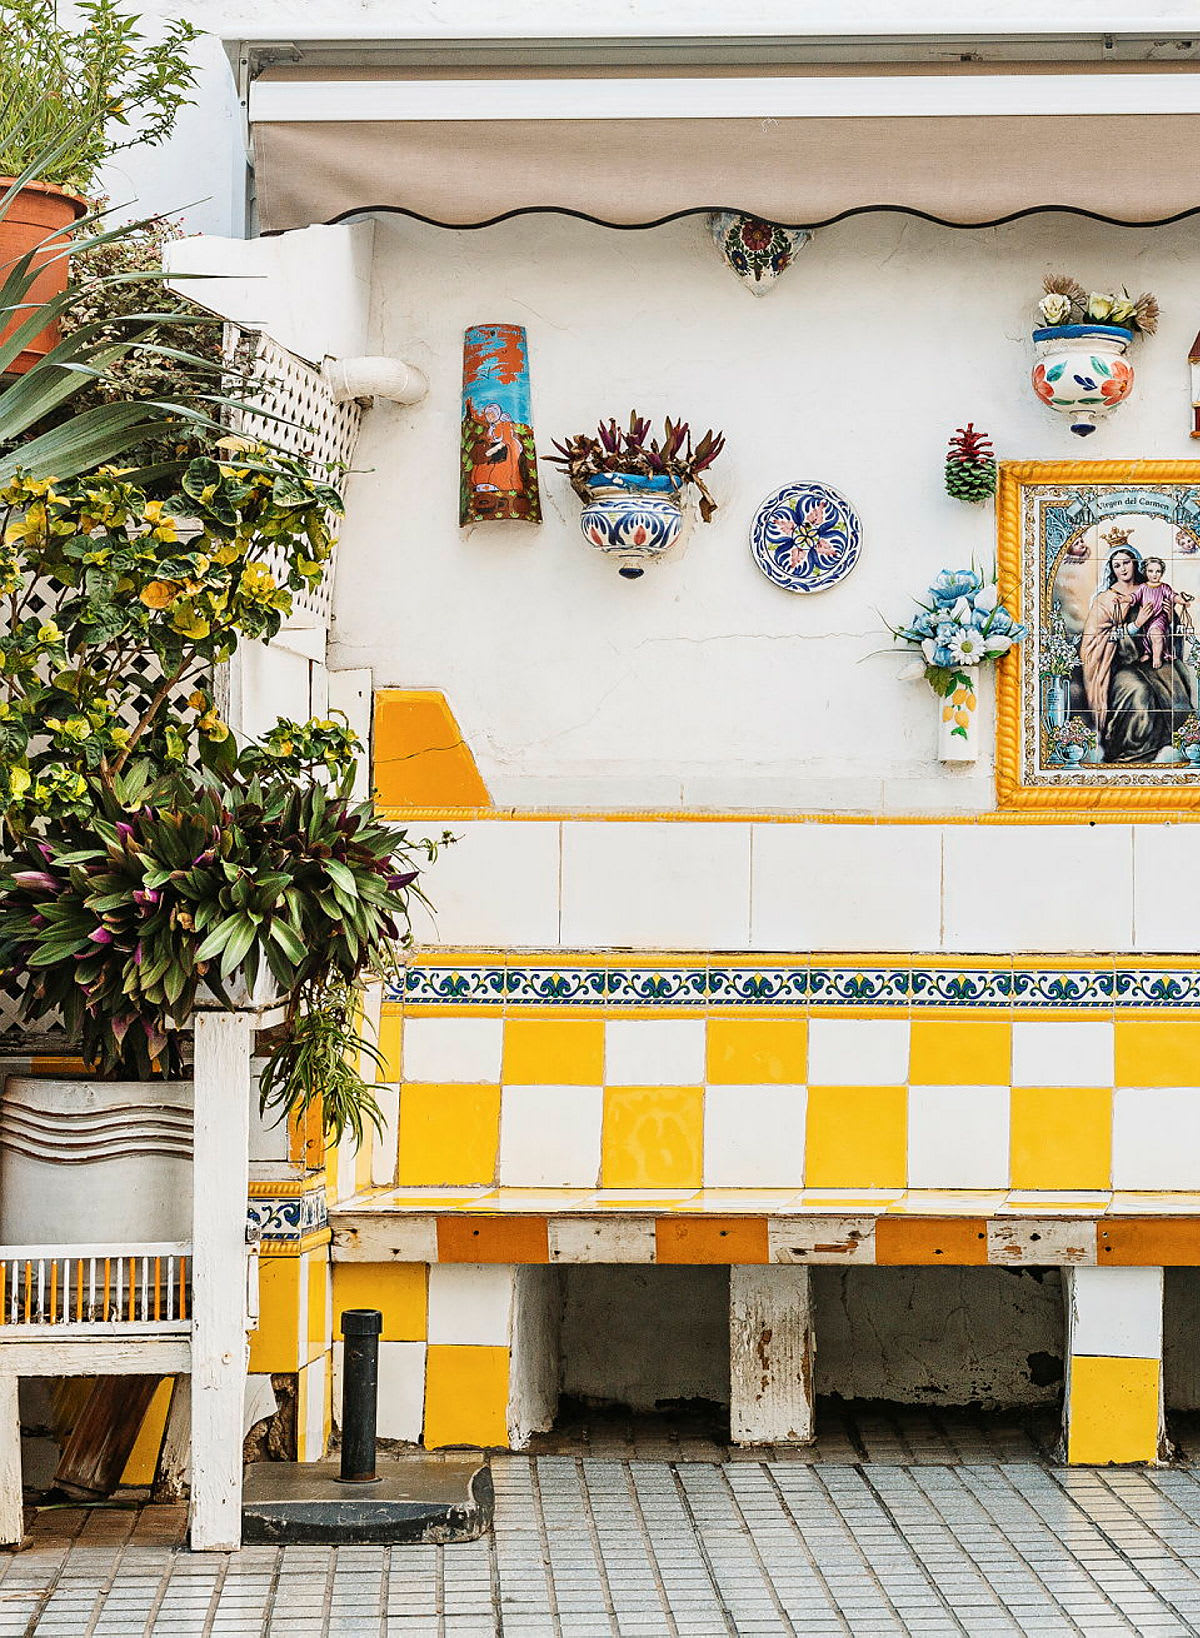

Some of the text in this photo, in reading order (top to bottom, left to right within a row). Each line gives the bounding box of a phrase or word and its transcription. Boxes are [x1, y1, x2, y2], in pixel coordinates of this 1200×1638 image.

[1097, 497, 1169, 510] Virgen del Carmen
